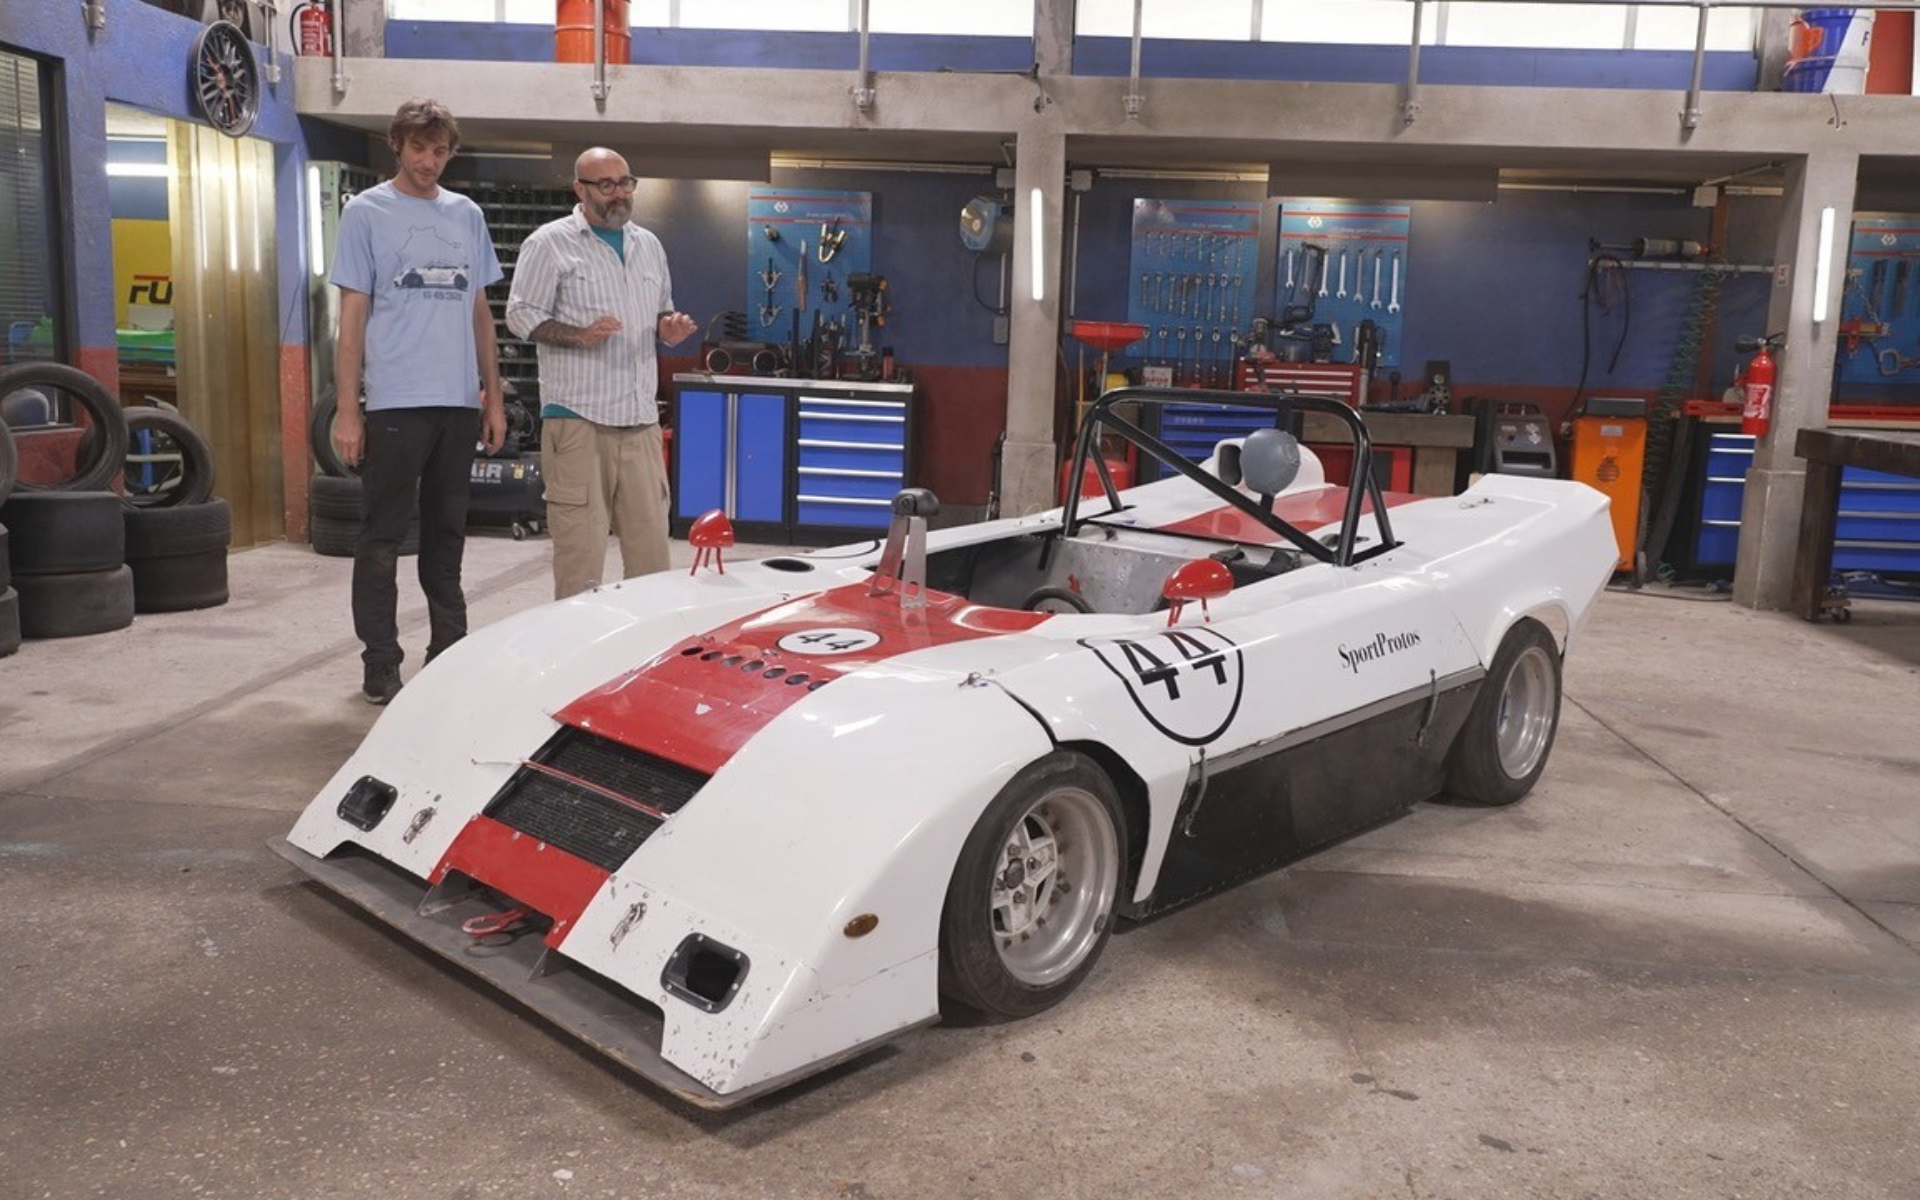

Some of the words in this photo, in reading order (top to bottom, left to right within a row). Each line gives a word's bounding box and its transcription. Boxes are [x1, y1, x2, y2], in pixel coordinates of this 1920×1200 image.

[797, 632, 867, 651] 44
[1337, 631, 1421, 674] SportProtos
[1111, 631, 1227, 701] 44
